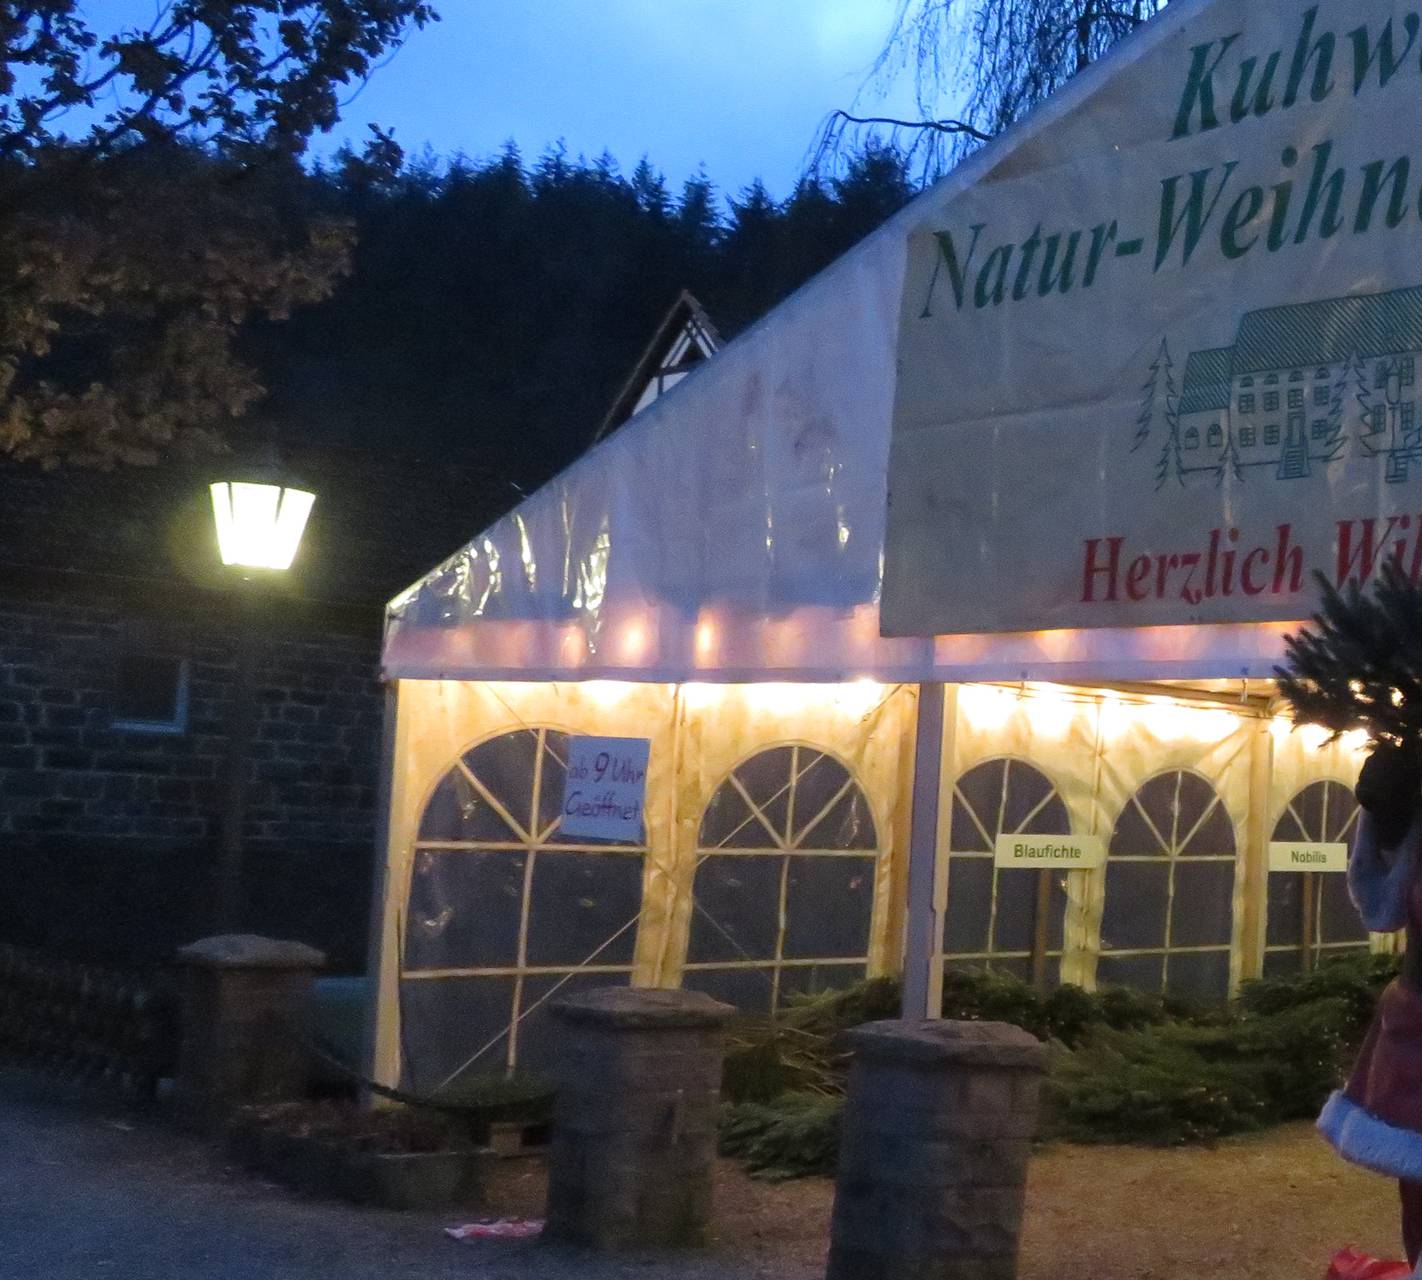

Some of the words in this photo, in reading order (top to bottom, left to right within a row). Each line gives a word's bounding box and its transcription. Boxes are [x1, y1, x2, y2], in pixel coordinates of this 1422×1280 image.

[1078, 523, 1305, 604] Herzlich
[568, 757, 589, 780] ab
[593, 751, 610, 784] 9
[612, 756, 644, 785] Uhr
[565, 790, 640, 821] Geöffnet
[1013, 843, 1082, 860] Blaufichte
[1290, 850, 1328, 864] Nobilis
